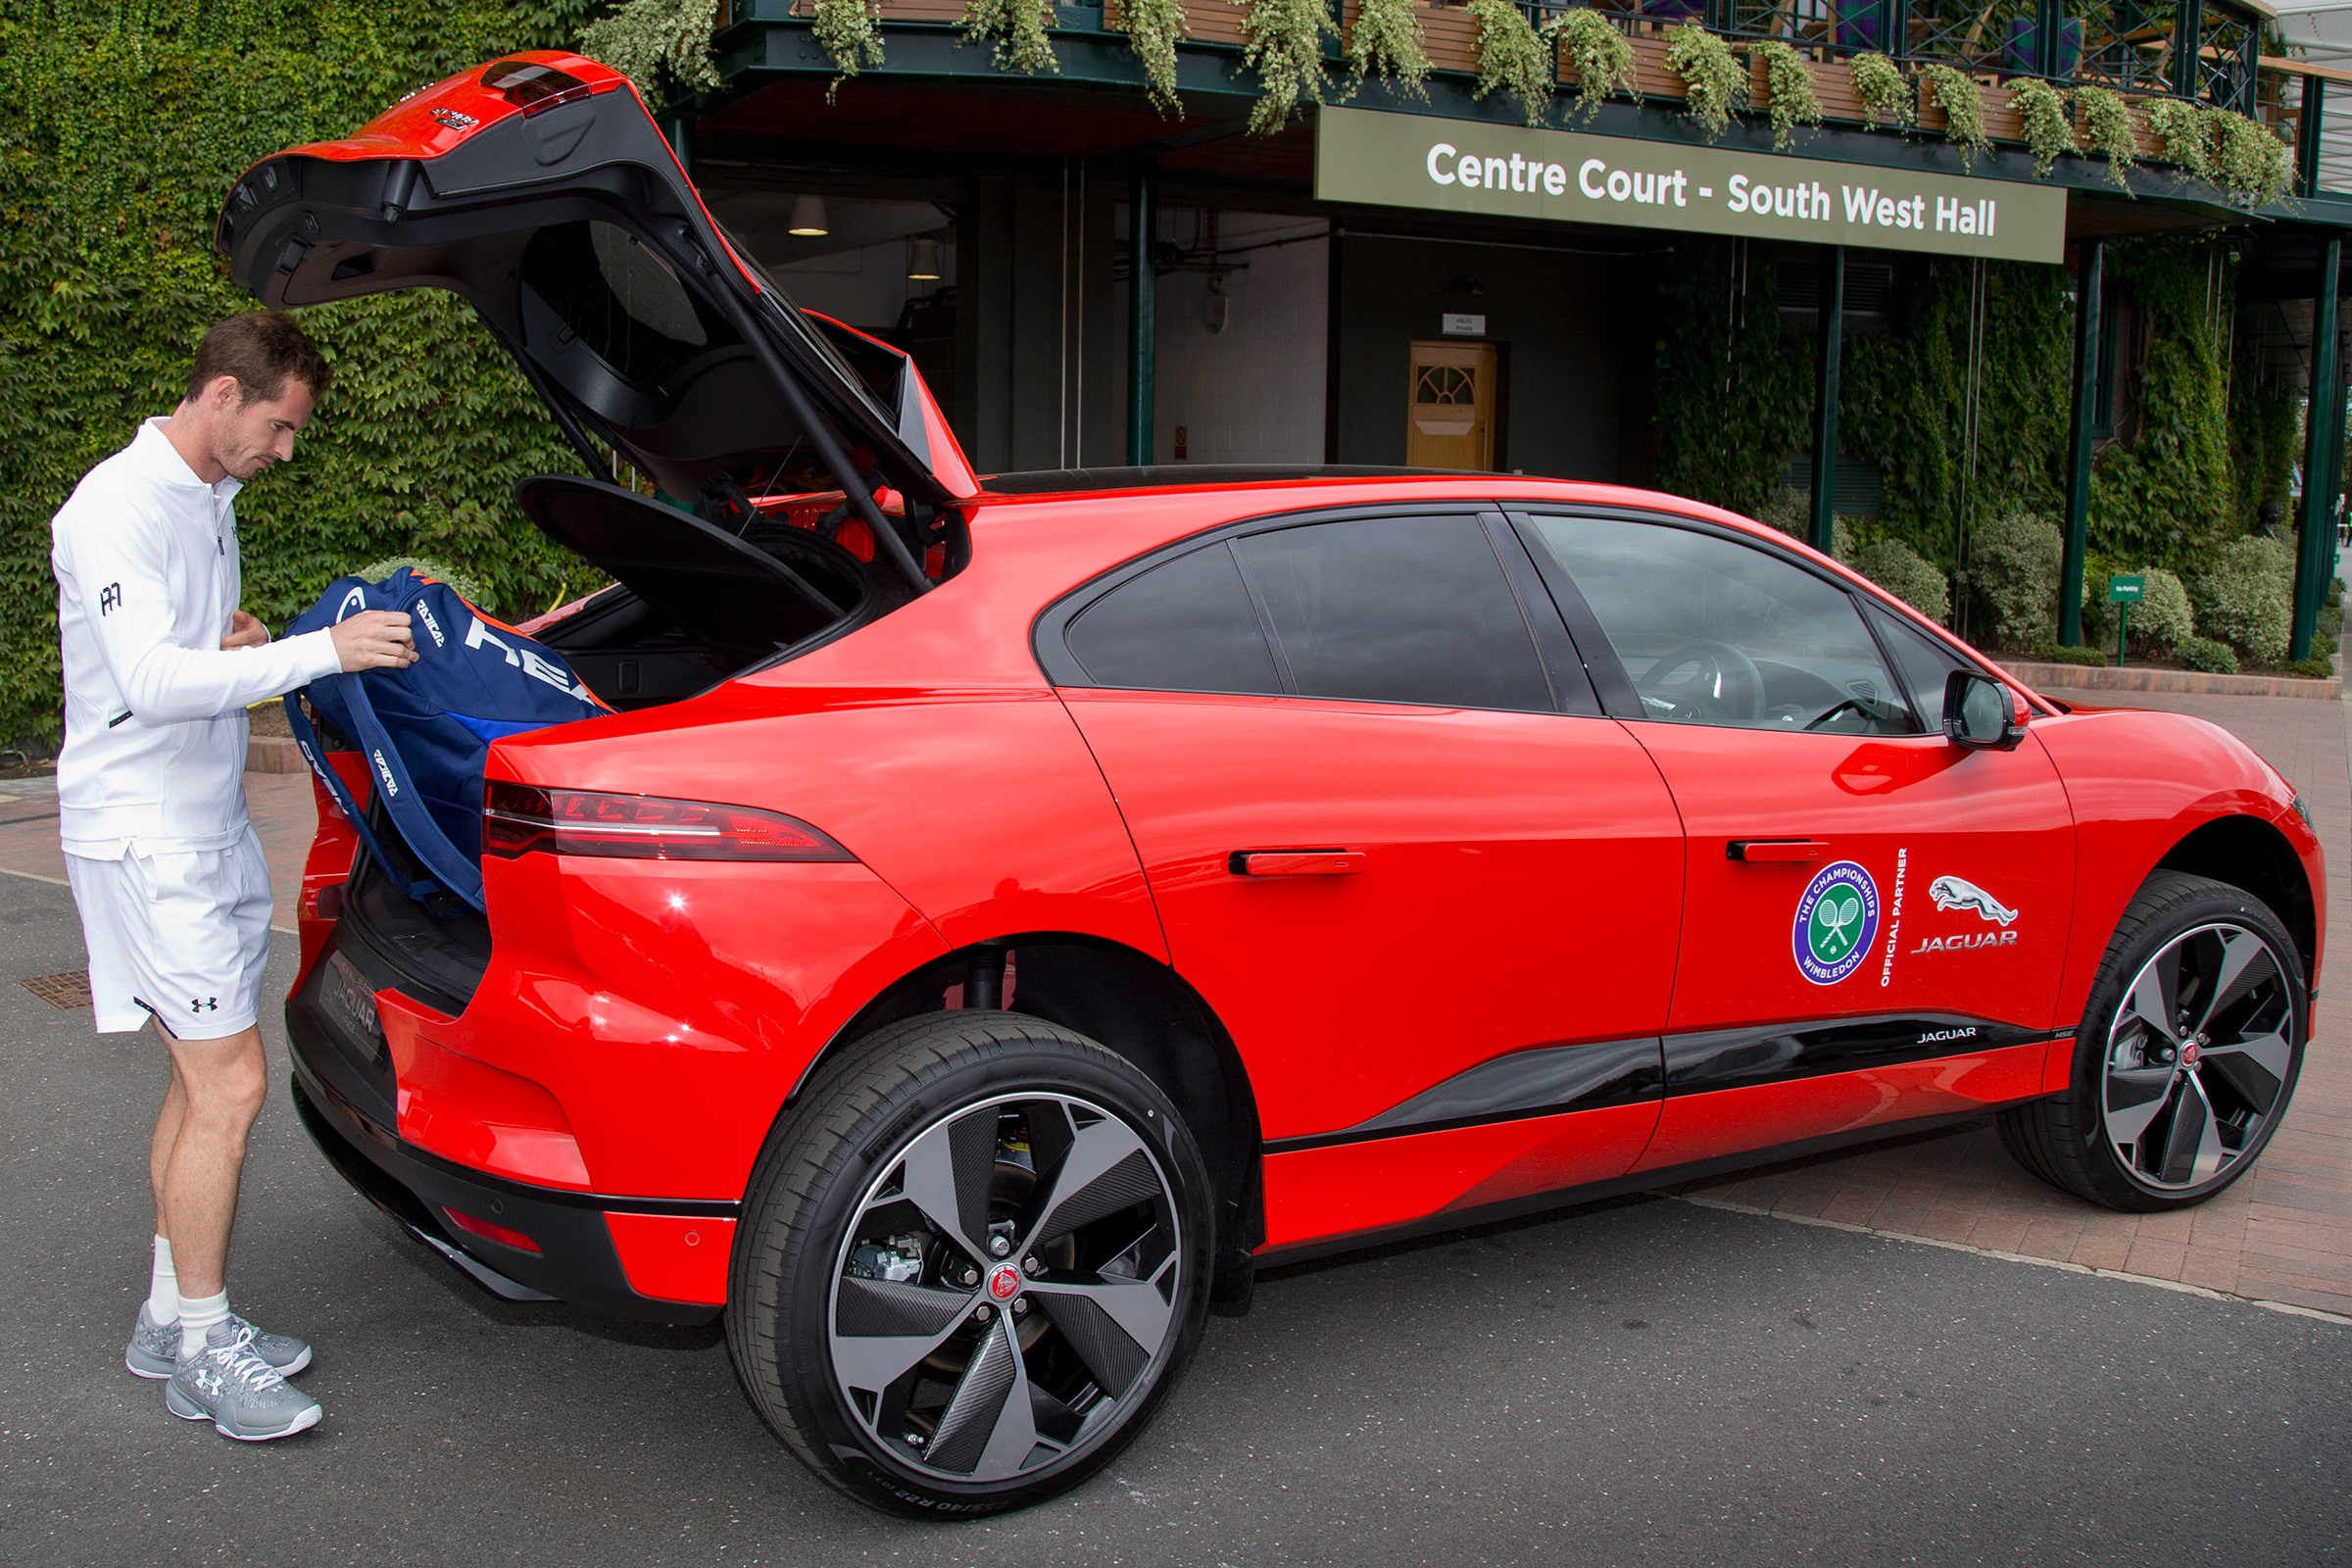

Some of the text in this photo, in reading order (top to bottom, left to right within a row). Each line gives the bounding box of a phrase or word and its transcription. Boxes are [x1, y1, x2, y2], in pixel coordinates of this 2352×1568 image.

[1427, 144, 1996, 237] Centre Court - South West Hall
[298, 739, 350, 816] HEAD
[1799, 867, 1876, 923] THE CHAMPIONSHIPS
[1881, 848, 1907, 987] OFFICIAL PARTNER
[1803, 951, 1861, 979] WIMBLEDON
[1910, 930, 2019, 955] JAGUAR
[333, 978, 375, 1034] JAGUAR
[1917, 1026, 1977, 1044] JAGUAR
[894, 1488, 936, 1508] R22
